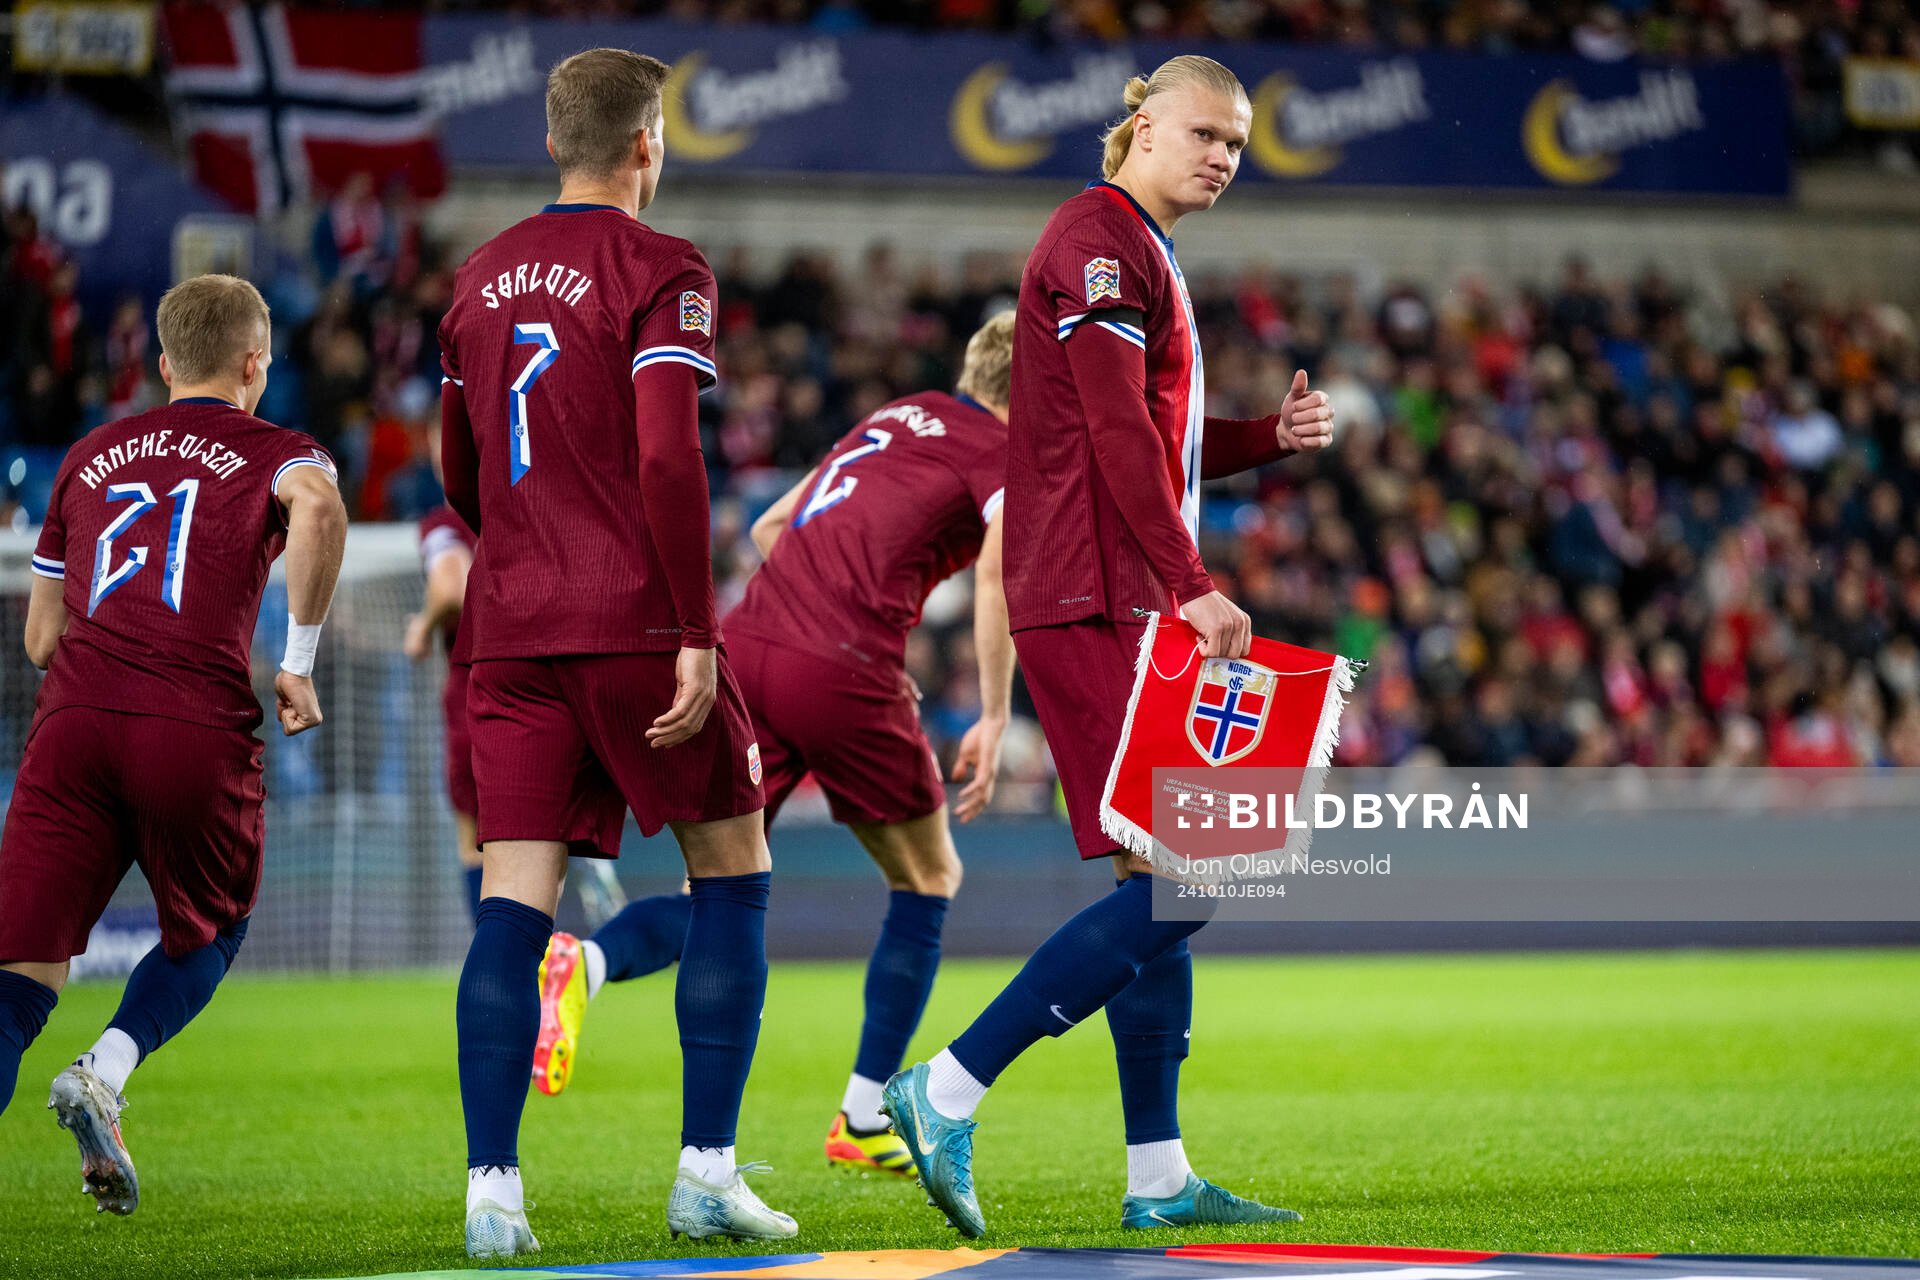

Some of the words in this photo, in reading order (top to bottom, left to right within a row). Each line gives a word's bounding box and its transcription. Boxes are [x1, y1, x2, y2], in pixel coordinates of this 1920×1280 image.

[509, 322, 561, 488] 7
[78, 429, 248, 490] HANCHE-OLSEN
[87, 478, 200, 618] 21
[1166, 778, 1182, 786] UEFA
[1183, 782, 1209, 792] NATIONS
[1209, 788, 1231, 798] LEAGU
